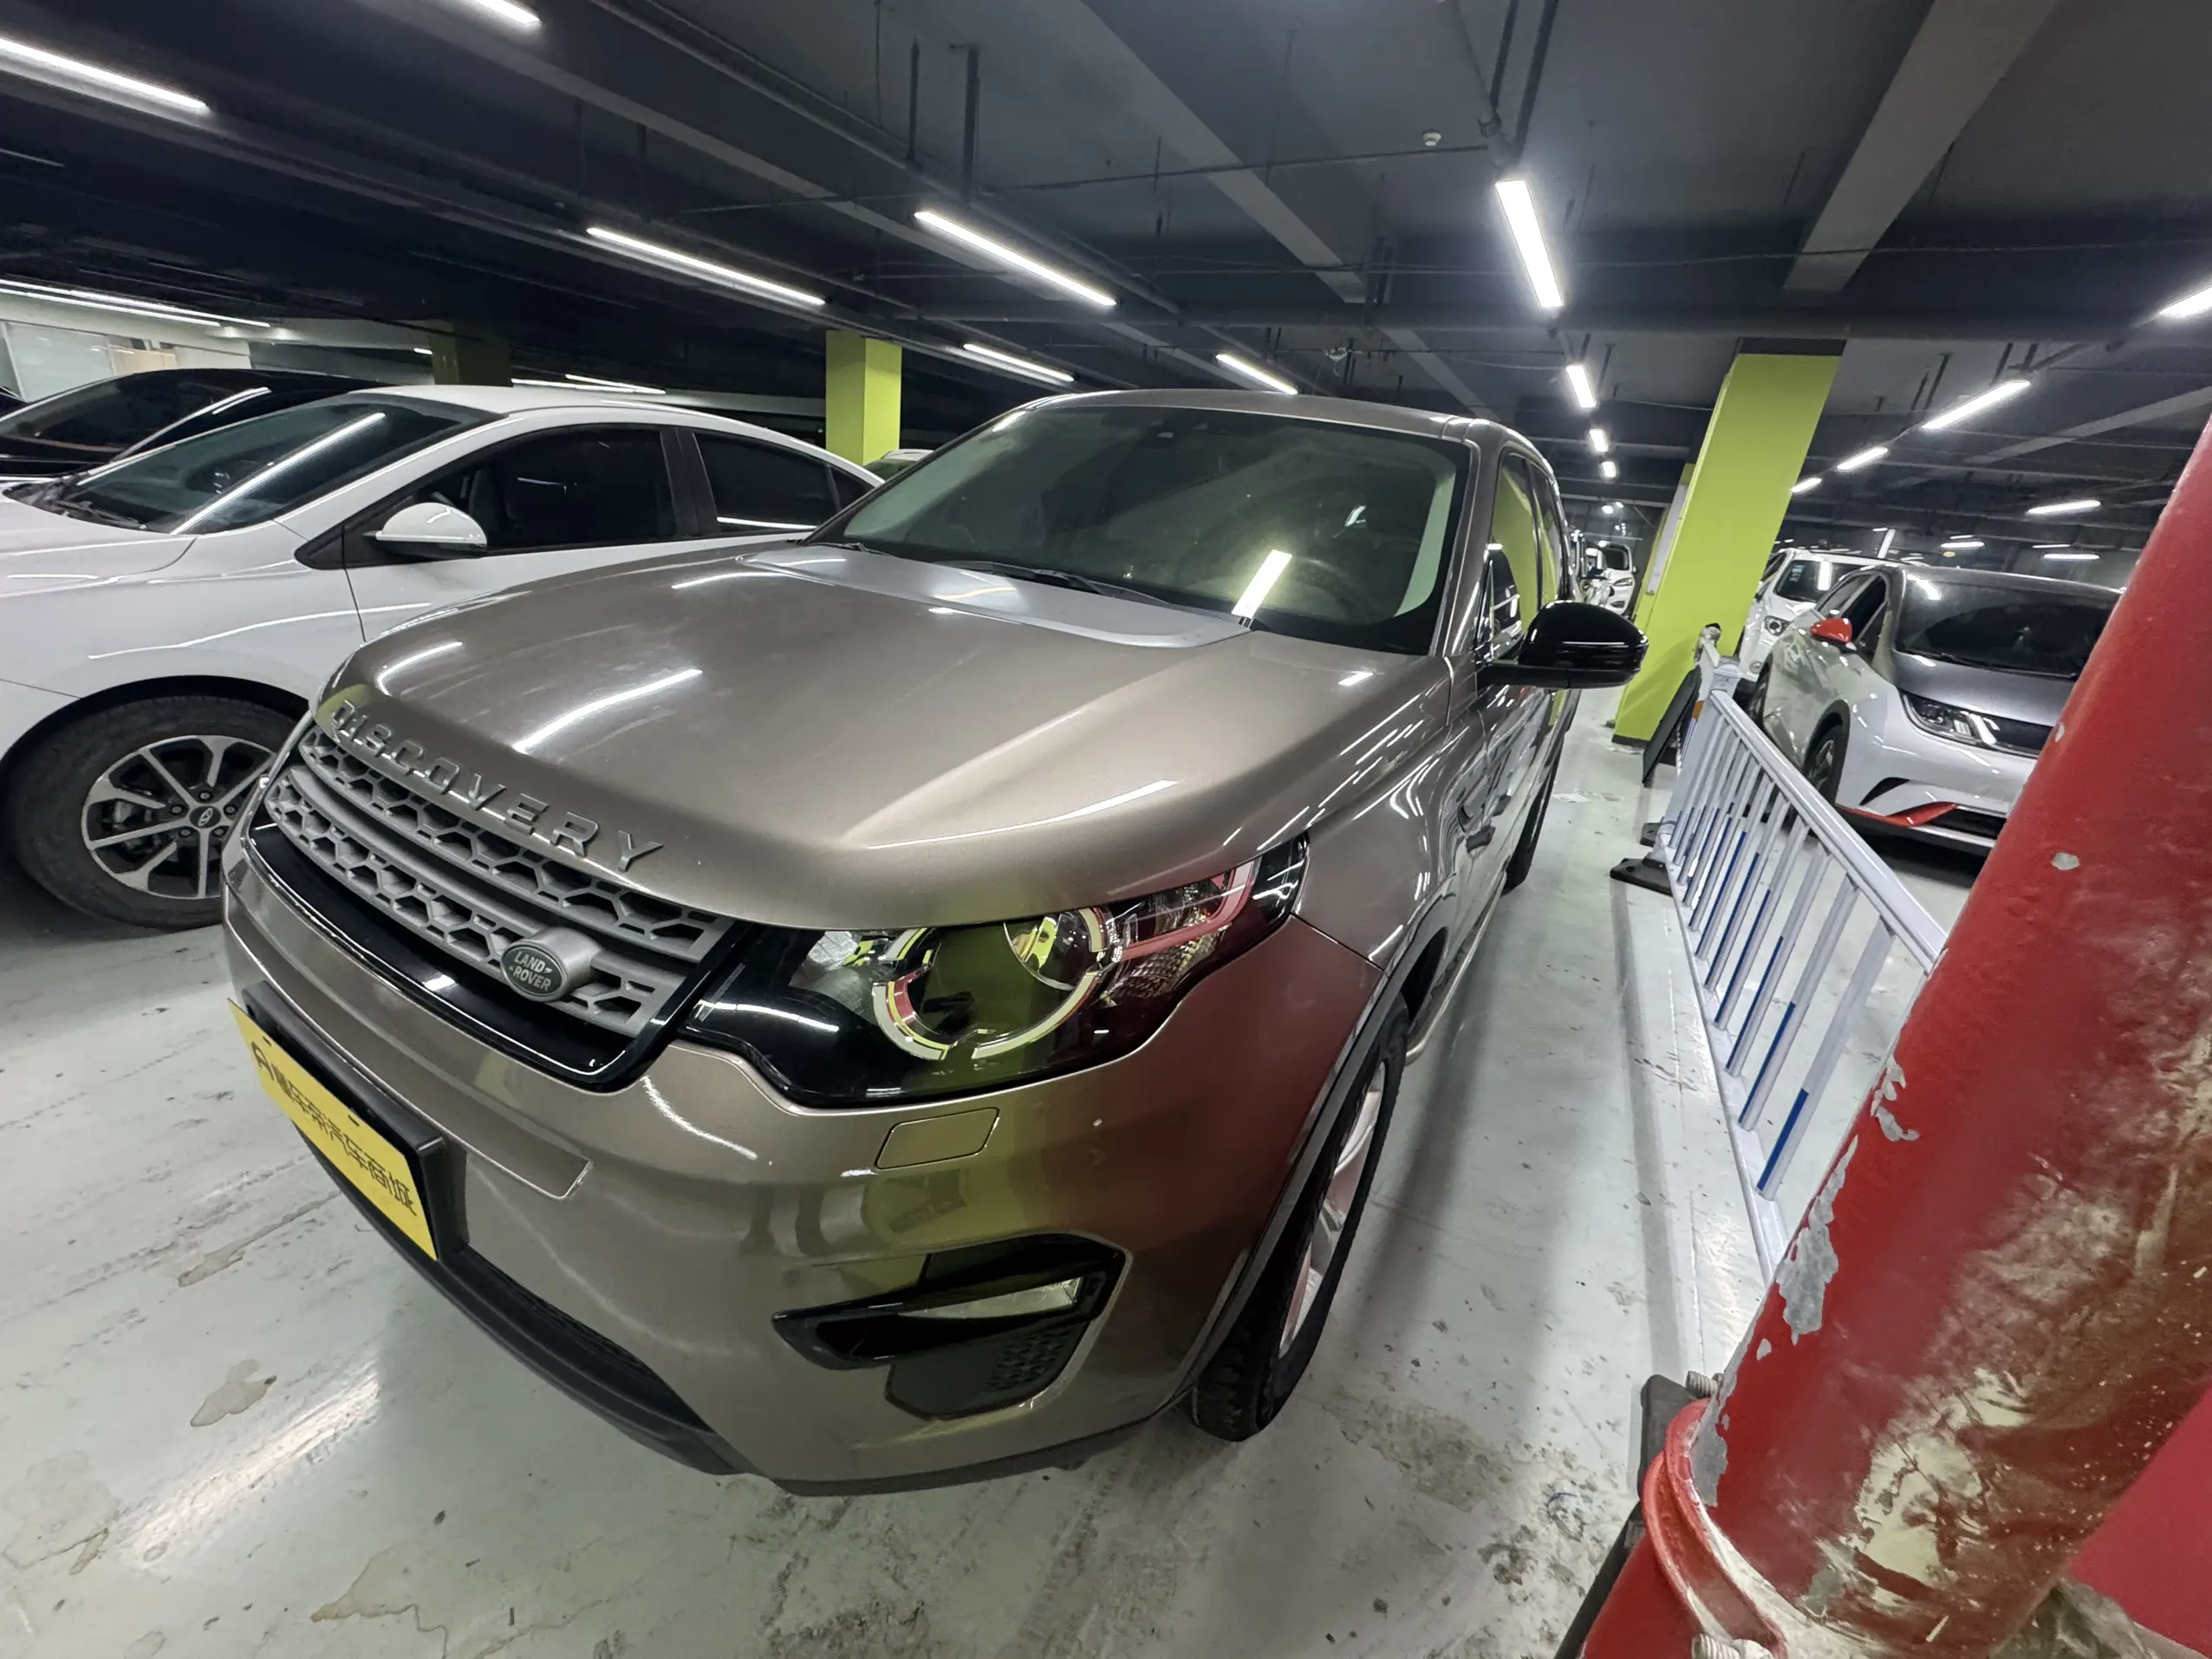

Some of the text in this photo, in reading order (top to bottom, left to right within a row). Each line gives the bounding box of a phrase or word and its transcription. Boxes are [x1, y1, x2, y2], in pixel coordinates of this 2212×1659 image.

[330, 699, 664, 872] DISCOVERY
[513, 951, 546, 973] LAND
[512, 965, 551, 992] ROVER
